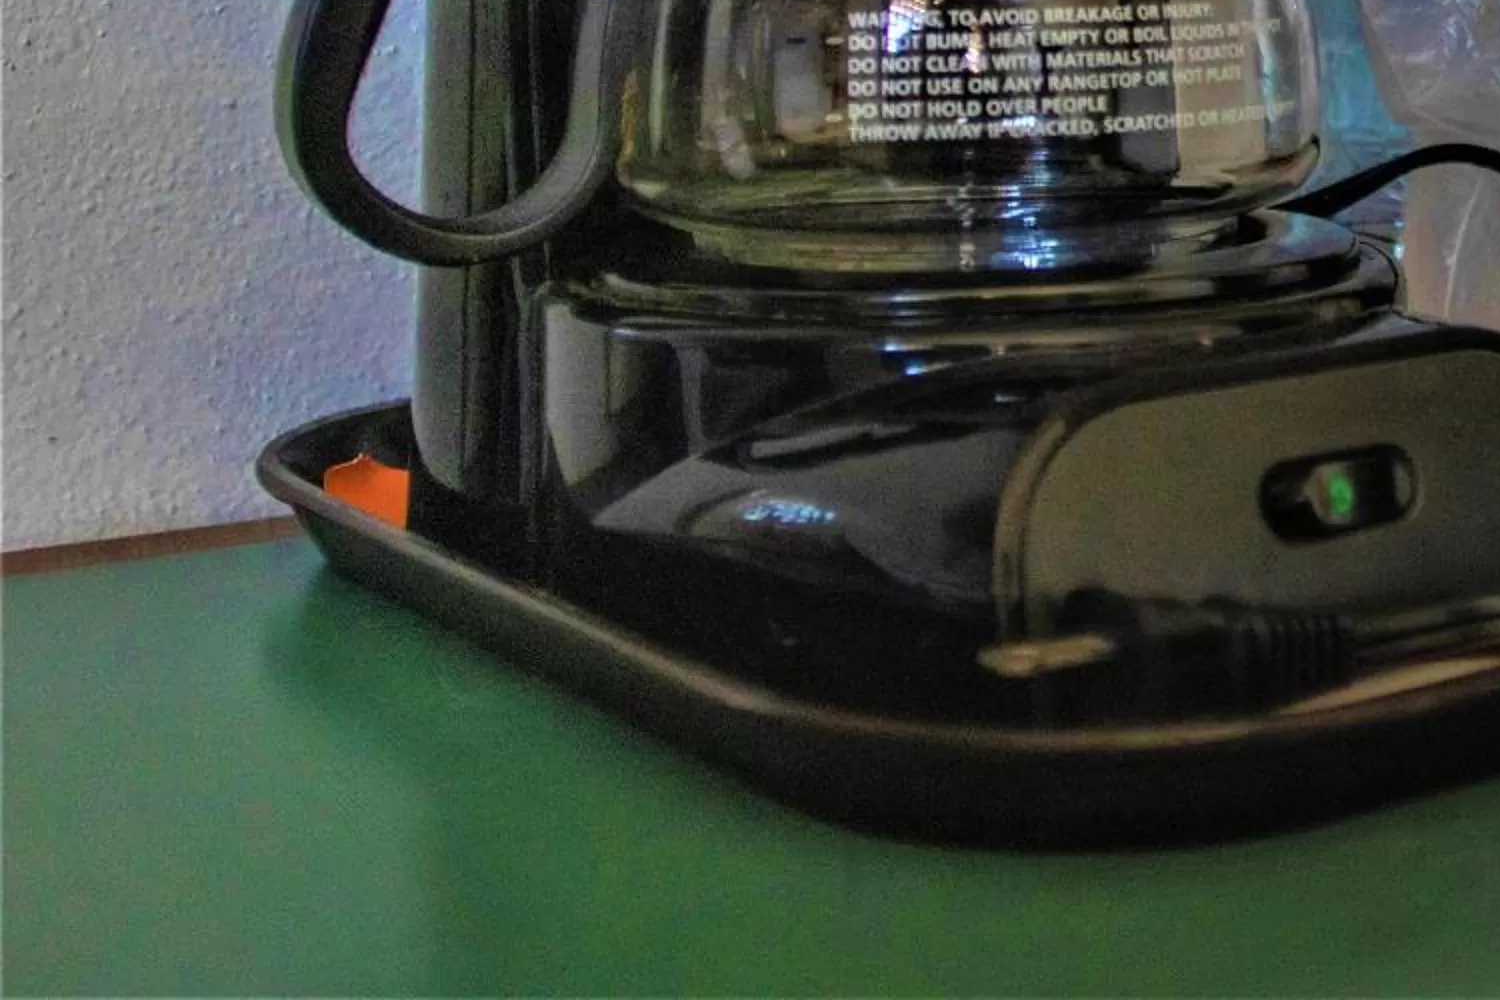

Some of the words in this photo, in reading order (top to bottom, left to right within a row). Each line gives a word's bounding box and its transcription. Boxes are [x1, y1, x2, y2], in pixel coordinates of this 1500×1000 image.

[948, 9, 976, 26] TO
[980, 7, 1038, 27] AVOID
[1043, 4, 1133, 24] BREAKAGE
[1137, 3, 1160, 21] OR
[848, 33, 876, 52] DO
[882, 33, 921, 52] OT
[988, 29, 1035, 48] HEAT
[1041, 27, 1099, 48] EMPTY
[1105, 26, 1129, 45] OR
[1133, 24, 1168, 43] BOIL
[848, 56, 876, 75] DO
[881, 55, 922, 75] NOT
[991, 52, 1041, 71] WITH
[1046, 49, 1142, 70] MATERIALS
[1146, 48, 1183, 64] THAT
[848, 79, 876, 98] DO
[881, 79, 922, 97] NOT
[926, 77, 963, 96] USE
[967, 76, 998, 95] ON
[1003, 74, 1044, 93] ANY
[1047, 70, 1142, 92] RANGETOP
[1146, 69, 1169, 87] OR
[848, 102, 877, 120] DO
[881, 102, 922, 119] NOT
[927, 100, 982, 118] HOLD
[985, 97, 1037, 117] OVER
[1042, 95, 1108, 116] PEOPLE
[849, 124, 921, 143] THROW
[923, 122, 983, 141] AWAY
[1104, 111, 1196, 135] SCRATCHED
[1198, 109, 1219, 127] OR
